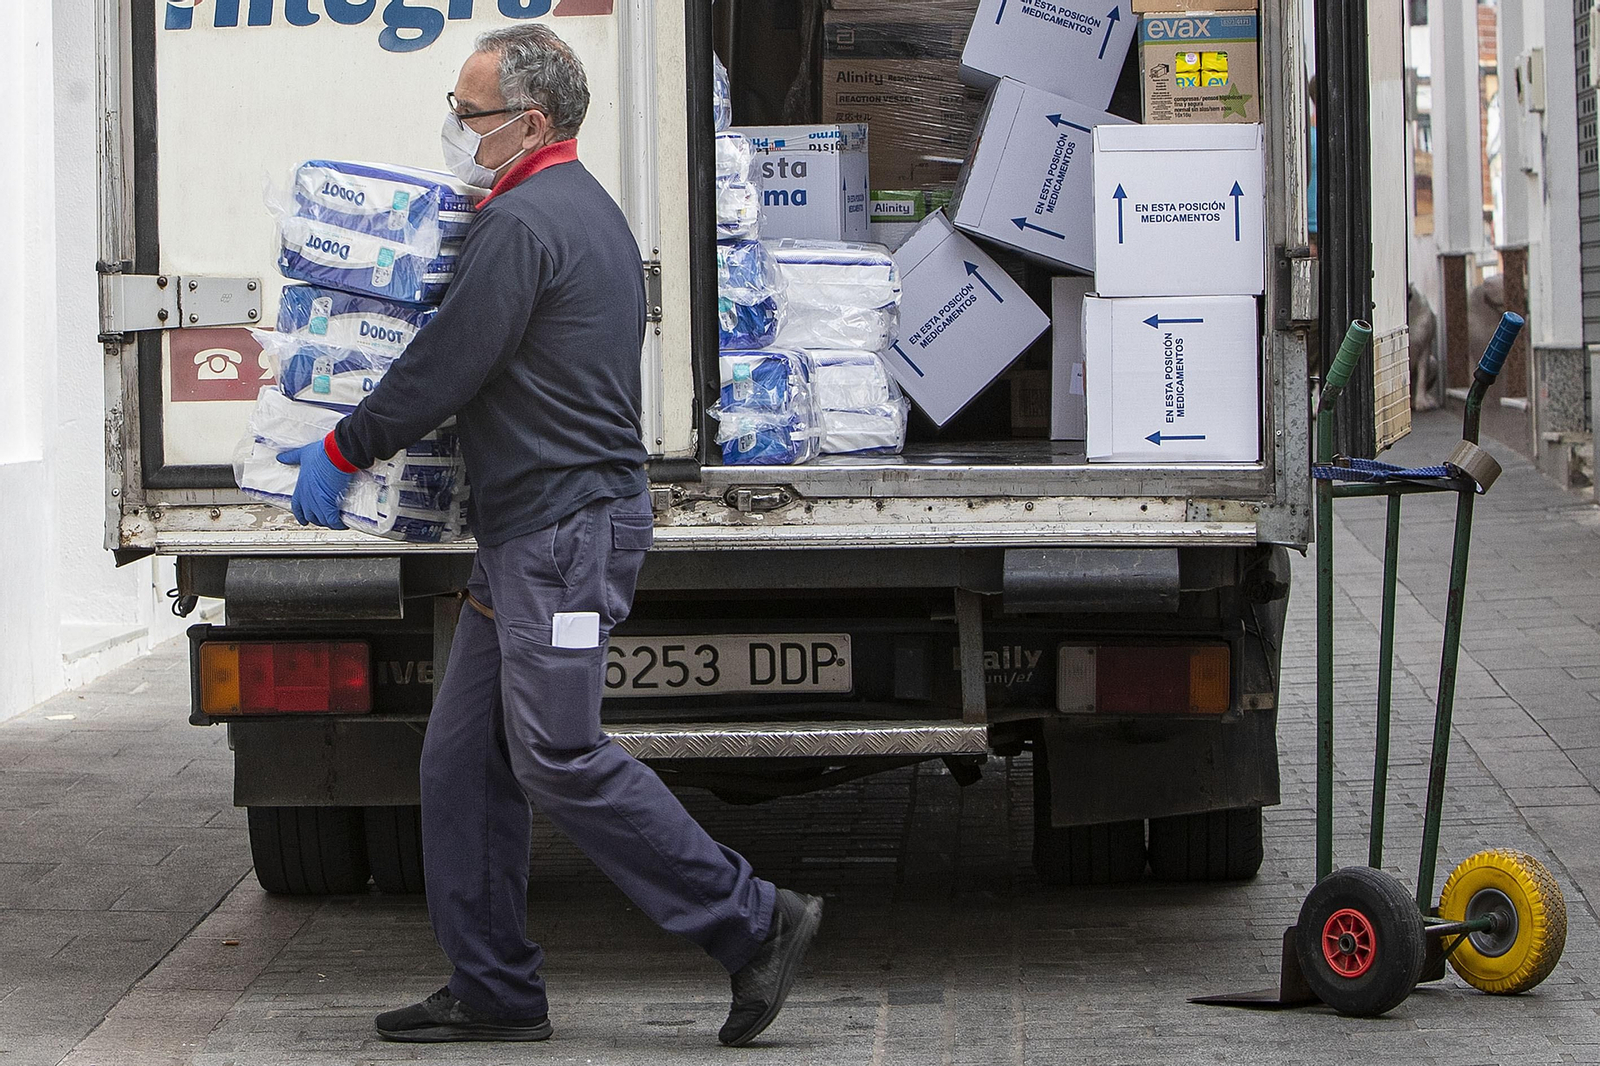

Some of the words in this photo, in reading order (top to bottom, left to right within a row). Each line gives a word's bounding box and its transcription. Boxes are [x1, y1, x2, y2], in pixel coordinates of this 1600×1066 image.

[1021, 6, 1093, 35] MEDICAMENTOS
[1034, 0, 1057, 13] ESTA
[1058, 7, 1101, 28] POSICIÓN
[1147, 19, 1211, 39] evax
[836, 71, 883, 85] Alinity
[839, 95, 880, 103] REACTION
[1035, 201, 1045, 215] EN
[1040, 177, 1053, 199] ESTA
[1048, 133, 1068, 177] POSICIÓN
[1046, 141, 1076, 214] MEDICAMENTOS
[321, 182, 365, 206] DODOT
[761, 189, 807, 206] ma
[1135, 203, 1148, 212] EN
[1151, 203, 1176, 212] ESTA
[1178, 200, 1226, 211] POSICIÓN
[874, 201, 910, 214] Alinity
[1141, 213, 1220, 223] MEDICAMENTOS
[306, 235, 350, 260] DODOT
[908, 331, 922, 345] EN
[920, 315, 941, 335] ESTA
[939, 283, 975, 317] POSICIÓN
[919, 294, 977, 349] MEDICAMENTOS
[359, 320, 404, 344] DODOT
[1162, 332, 1173, 380] POSICIÓN
[1175, 338, 1185, 418] MEDICAMENTOS
[1165, 382, 1174, 407] ESTA
[1165, 410, 1174, 423] EN
[605, 644, 720, 689] 6253
[749, 642, 838, 685] DDP
